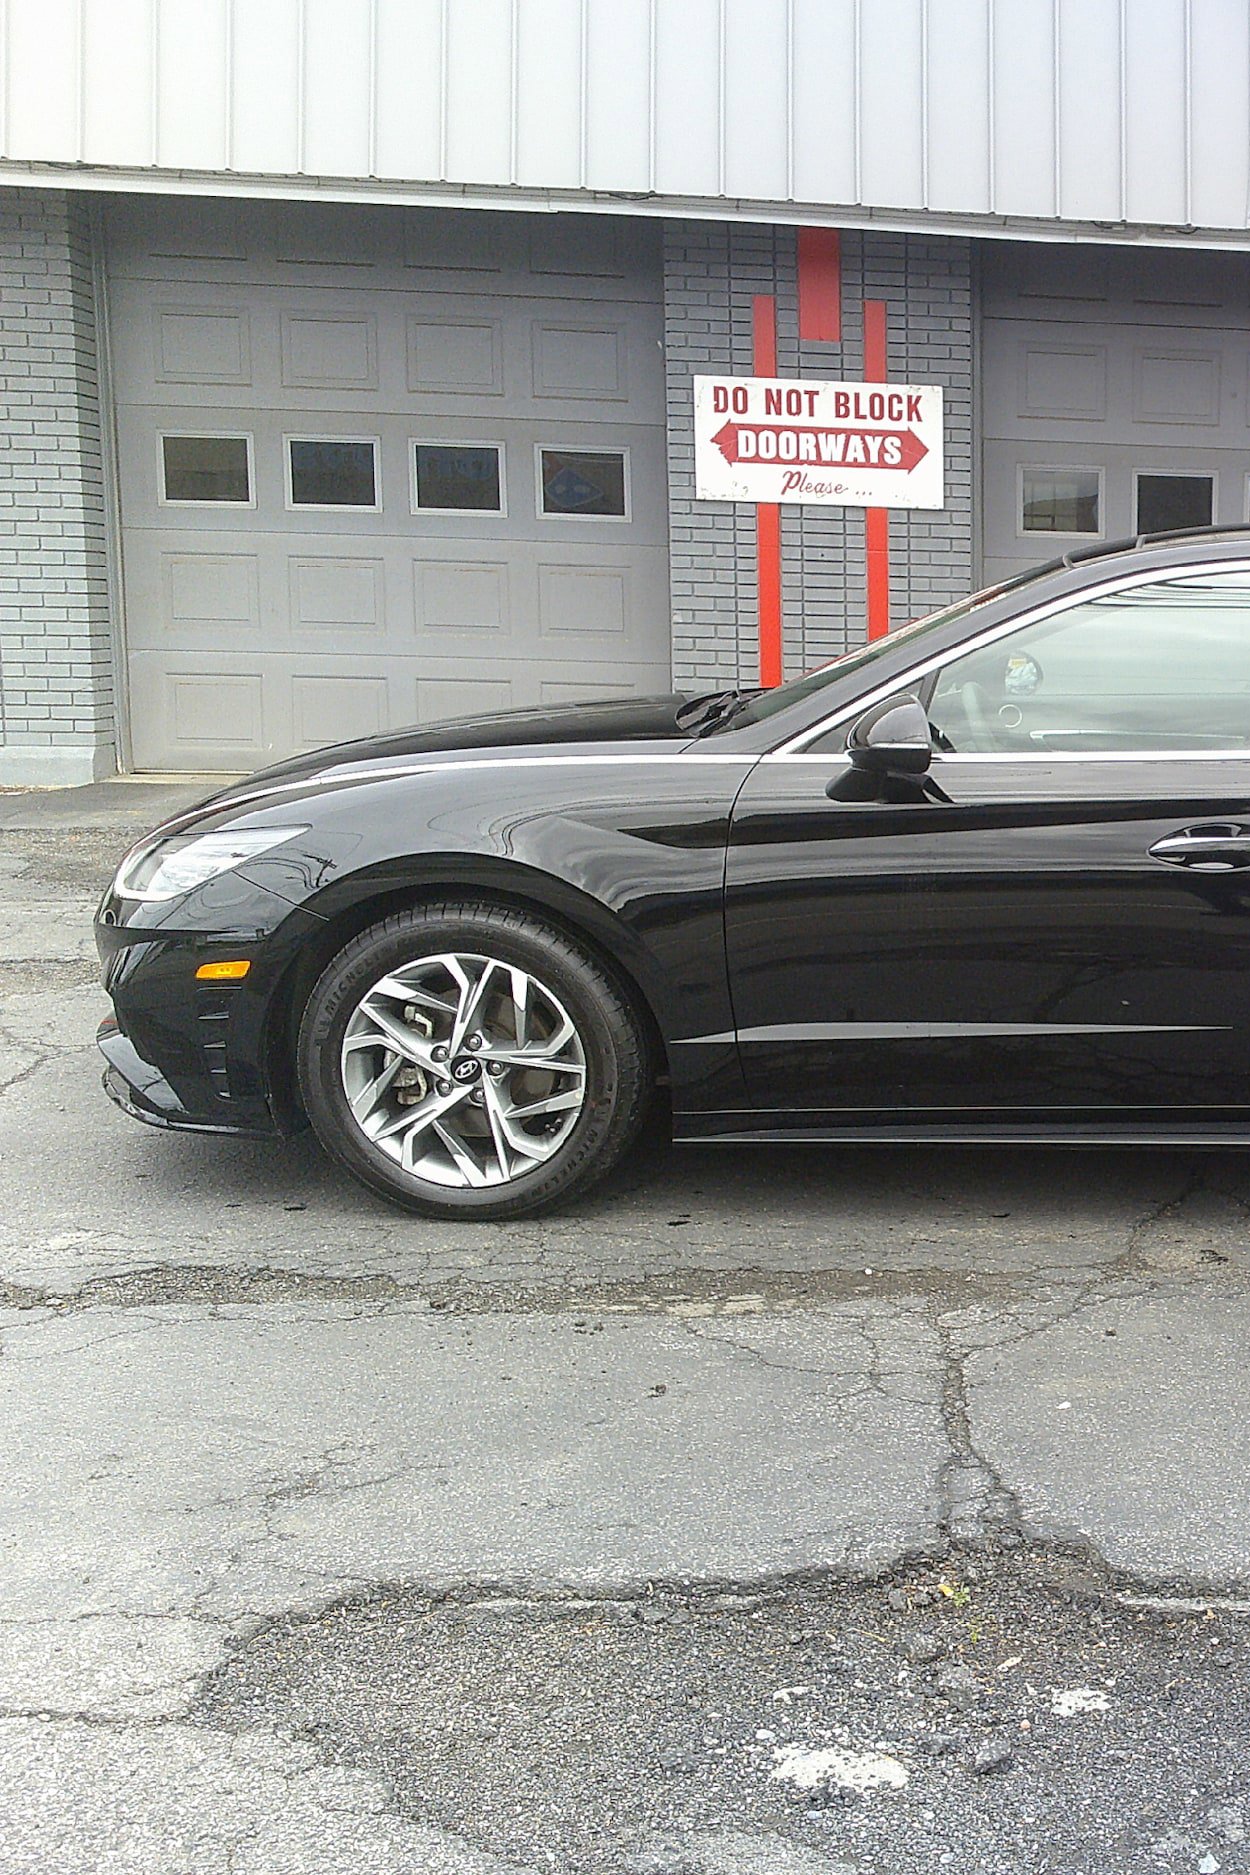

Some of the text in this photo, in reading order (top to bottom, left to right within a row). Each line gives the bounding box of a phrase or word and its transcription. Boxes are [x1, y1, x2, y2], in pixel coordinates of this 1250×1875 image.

[713, 386, 923, 422] DO NOT BLOCK
[737, 429, 901, 464] DOORWAYS
[781, 470, 848, 495] Please
